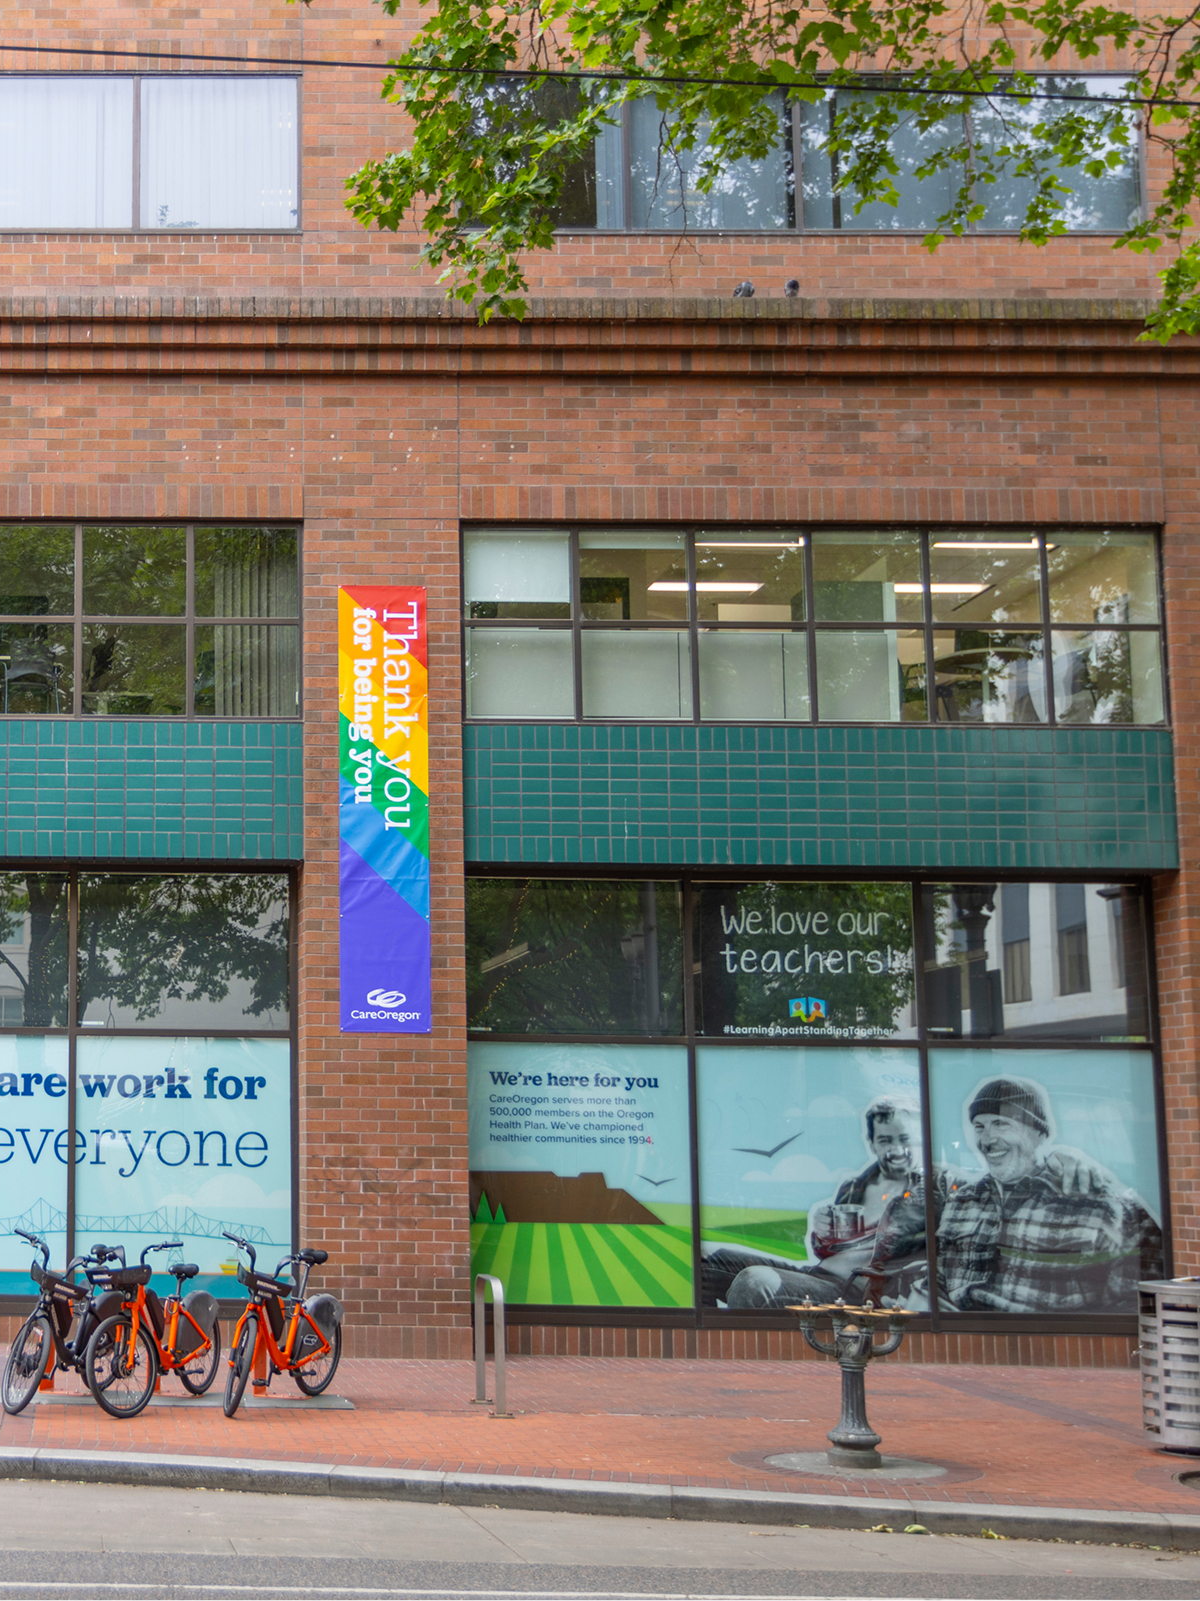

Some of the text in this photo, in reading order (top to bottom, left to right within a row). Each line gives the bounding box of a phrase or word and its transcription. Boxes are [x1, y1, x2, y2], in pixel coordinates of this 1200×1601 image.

[348, 607, 379, 804] for being you
[375, 601, 419, 831] Thank you
[720, 905, 889, 936] We love our
[350, 1010, 420, 1023] CareOregon
[723, 1024, 894, 1037] #LearningApartStandingTogether
[79, 1067, 192, 1099] work
[204, 1067, 267, 1100] for
[489, 1071, 659, 1091] We’re here for you
[489, 1094, 636, 1106] CareOregon serves more than
[489, 1107, 654, 1120] 500,000 members on the Oregon
[489, 1120, 521, 1130] Health
[524, 1120, 548, 1130] Plan.
[583, 1122, 643, 1133] championed
[489, 1133, 654, 1145] healthier communities since 1994.
